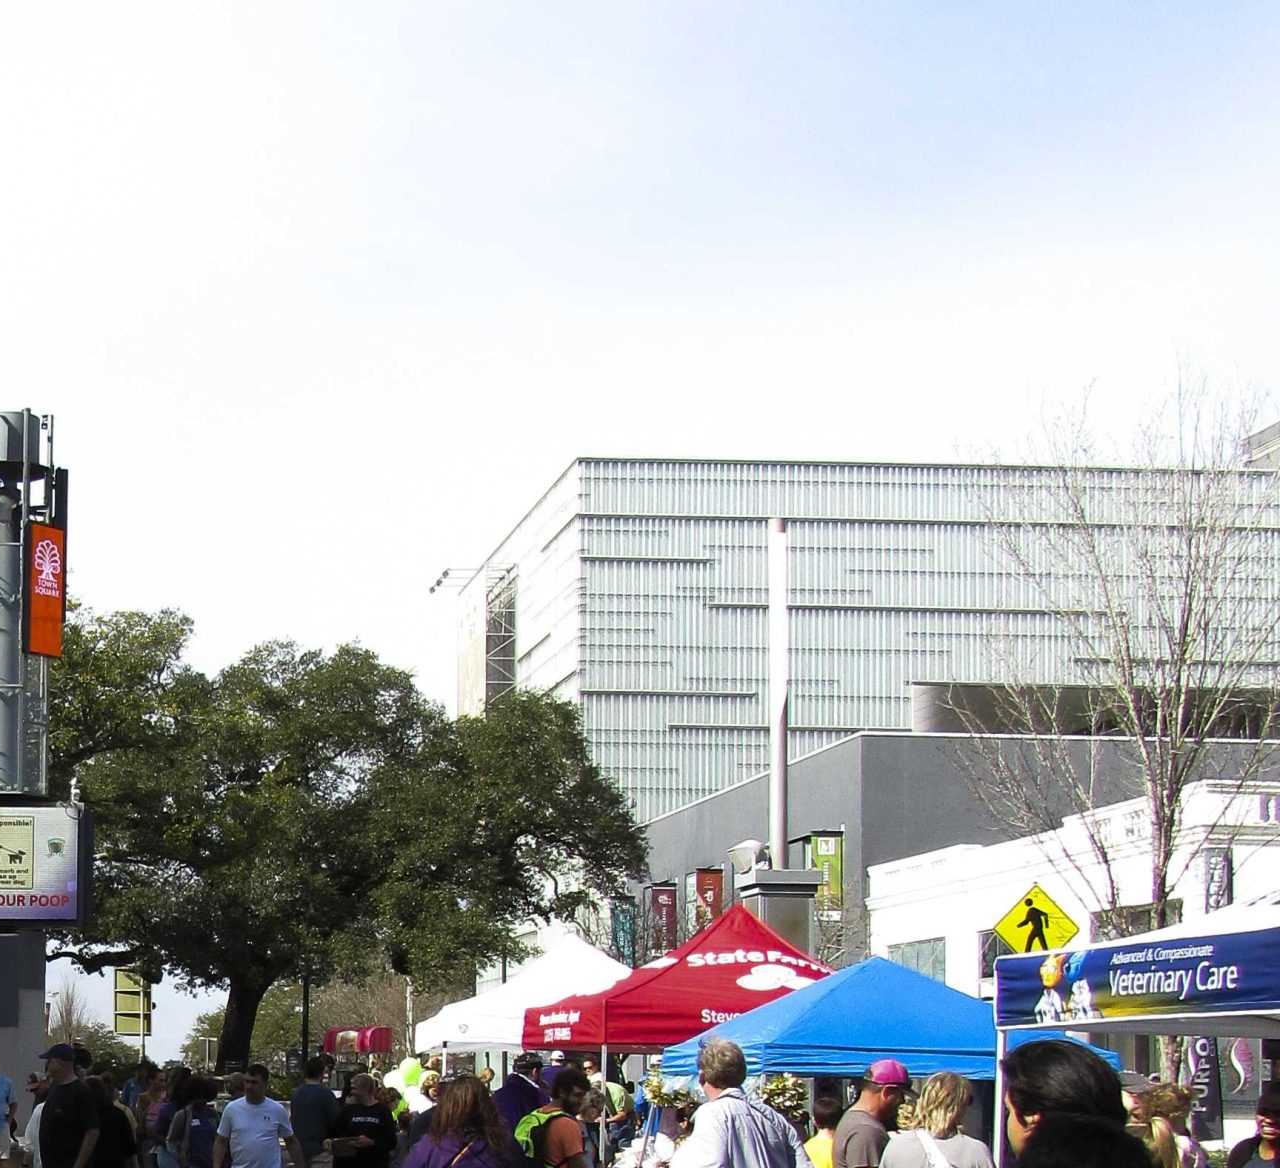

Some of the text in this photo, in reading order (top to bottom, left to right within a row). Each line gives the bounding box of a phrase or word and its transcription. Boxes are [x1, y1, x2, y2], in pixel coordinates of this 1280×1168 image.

[35, 586, 59, 597] SQUARE
[38, 578, 57, 590] TOWN
[29, 894, 70, 907] POOP
[686, 949, 765, 967] State
[1110, 944, 1214, 965] Advanced & Compassionate
[1109, 960, 1238, 1000] Veterinary Care
